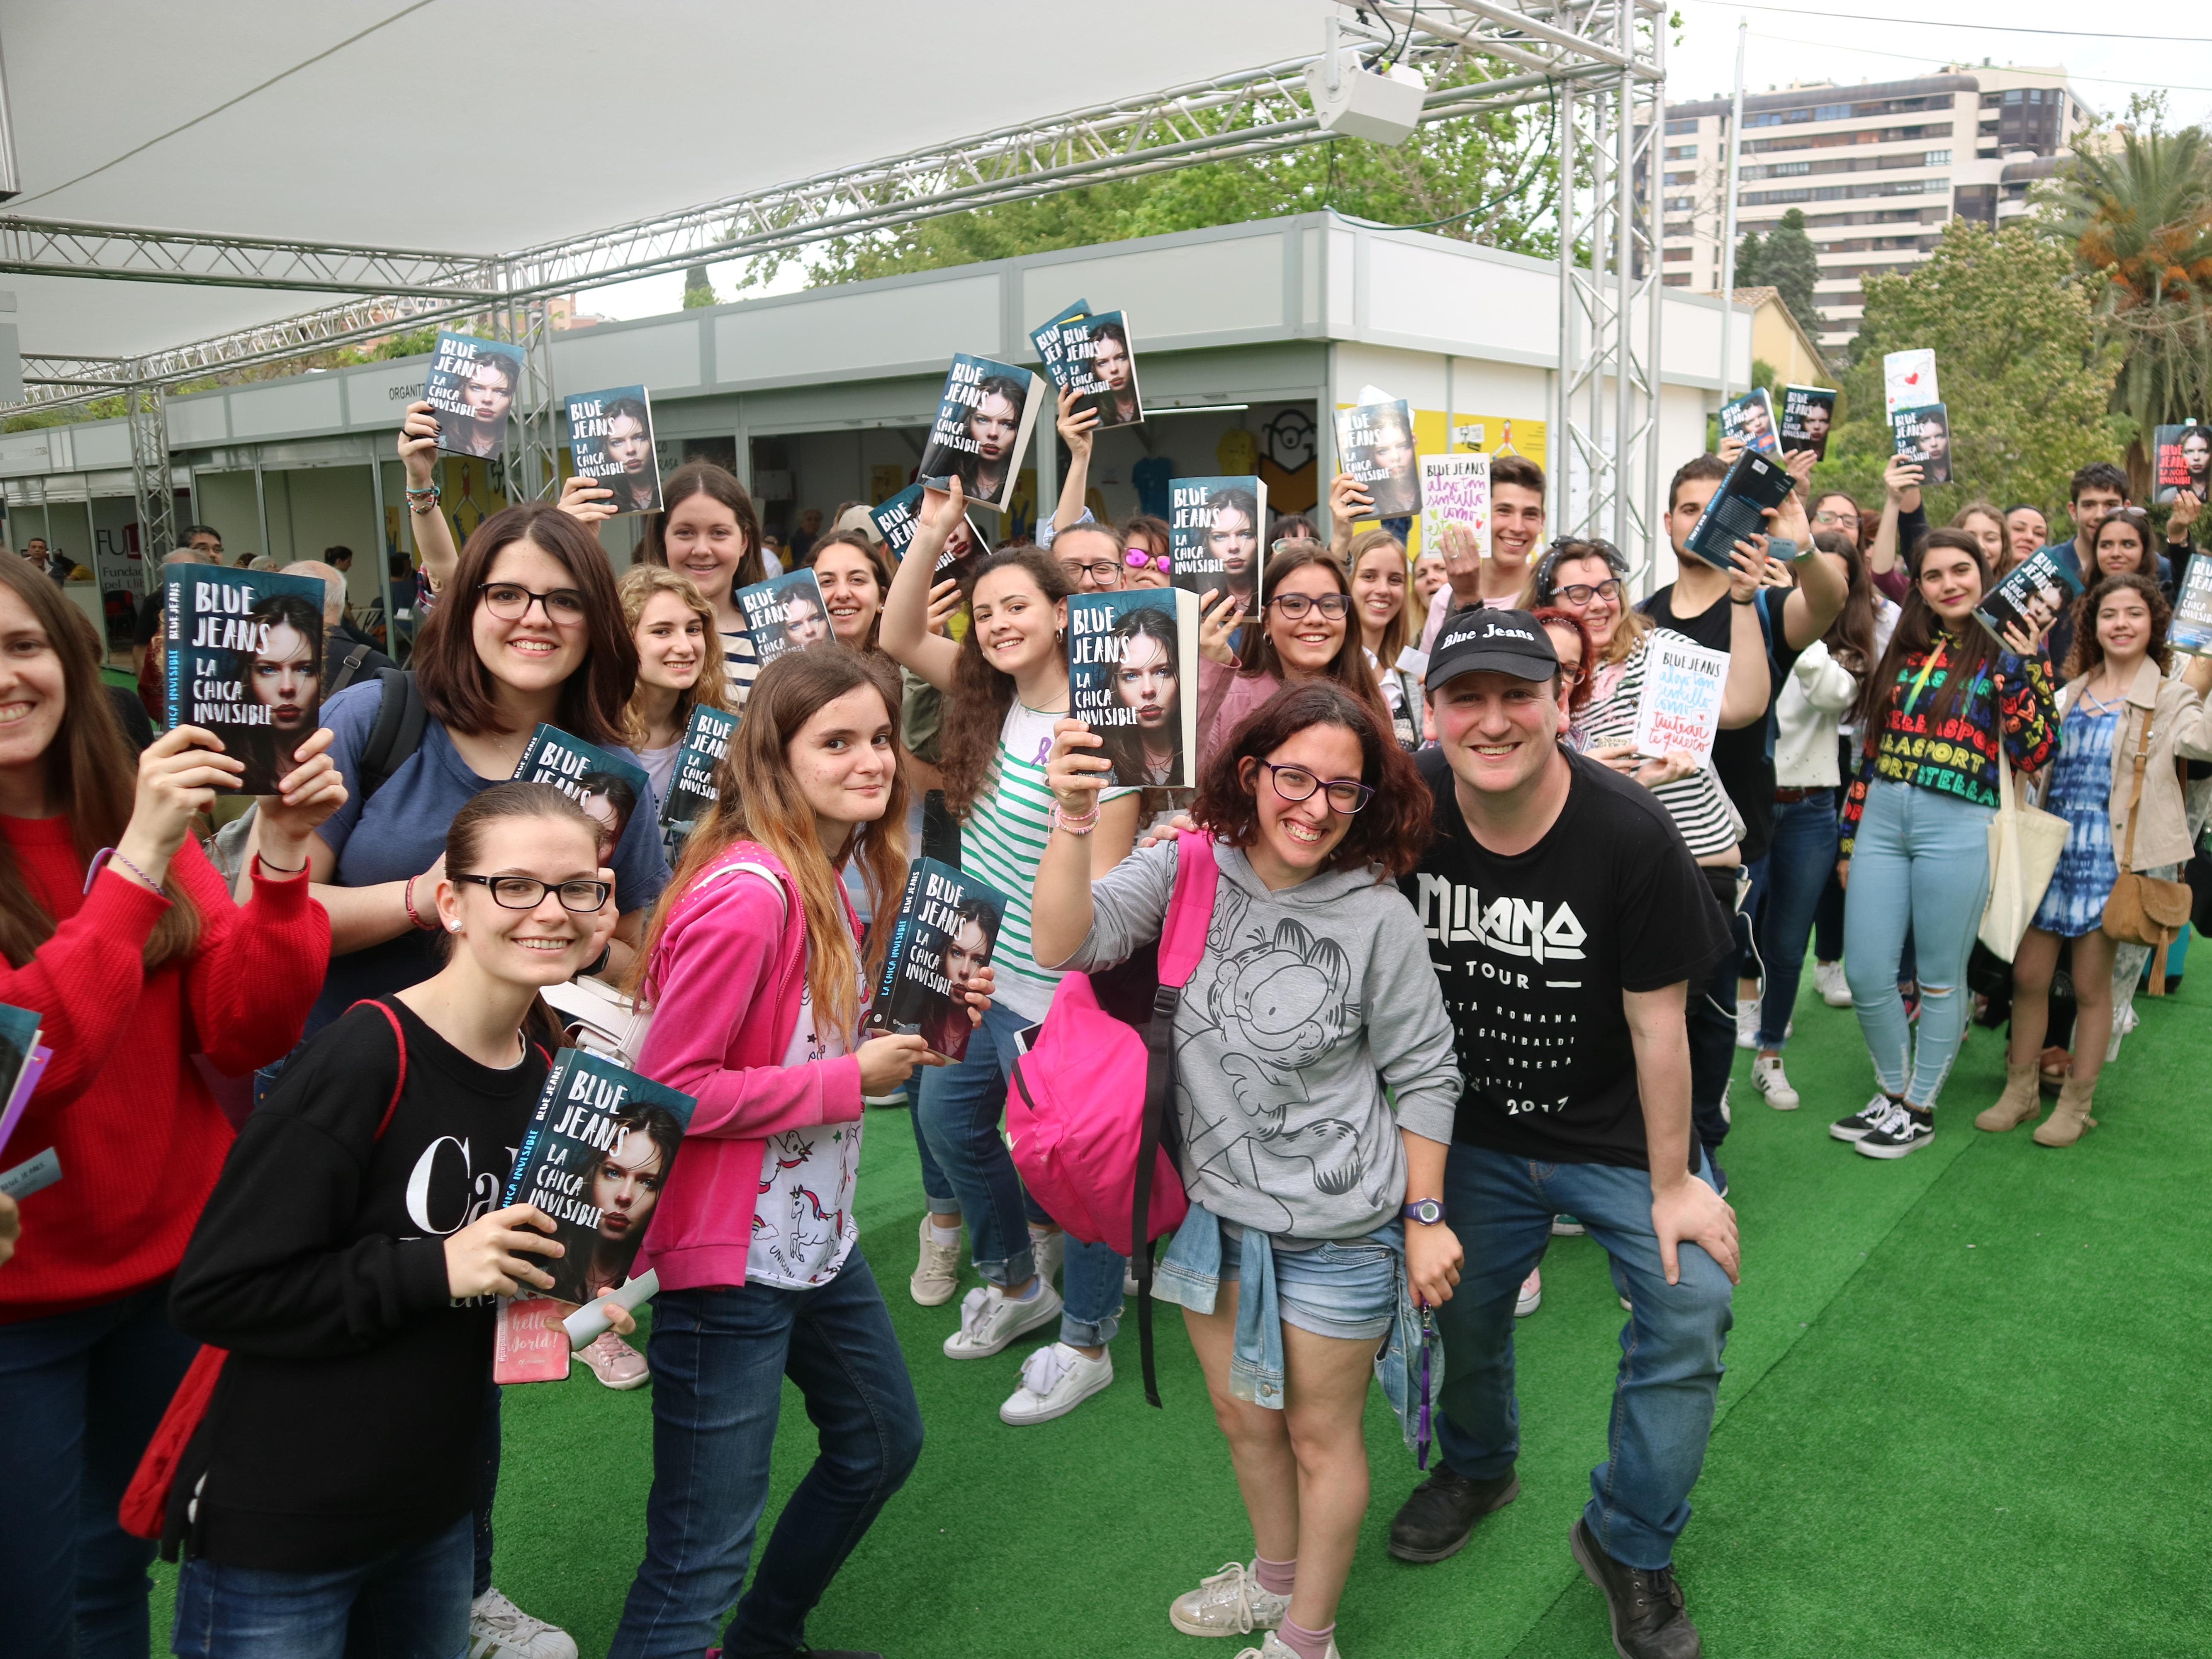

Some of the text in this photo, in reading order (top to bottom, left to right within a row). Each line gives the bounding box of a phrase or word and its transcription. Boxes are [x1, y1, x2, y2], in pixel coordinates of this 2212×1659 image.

[1063, 325, 1090, 346] BLUE
[440, 338, 478, 360] BLUE
[1044, 341, 1063, 365] JEA
[1066, 341, 1101, 362] JEANS
[434, 356, 484, 381] JEANS
[951, 362, 984, 386] BLUE
[1069, 365, 1080, 375] LA
[1071, 372, 1094, 387] CHICA
[433, 375, 446, 387] LA
[428, 386, 460, 402] CHICA
[944, 382, 990, 411] JEANS
[1787, 391, 1809, 404] BLUE
[426, 396, 477, 418] INVISIBLE
[570, 399, 603, 421] BLUE
[941, 405, 951, 418] LA
[1785, 403, 1813, 416] JEANS
[572, 417, 616, 440] JEANS
[936, 419, 964, 435] CHICA
[1339, 414, 1370, 431] BLUE
[1895, 412, 1918, 427] BLUE
[1342, 428, 1382, 449] JEANS
[1896, 423, 1925, 439] JEANS
[576, 444, 589, 455] LA
[932, 431, 981, 455] INVISIBLE
[2159, 444, 2183, 456] BLUE
[576, 452, 605, 467] CHICA
[1346, 452, 1357, 461] LA
[1346, 460, 1372, 472] CHICA
[2159, 456, 2189, 468] JEANS
[578, 461, 625, 477] INVISIBLE
[1352, 467, 1390, 482] NVISIBLE
[1427, 462, 1485, 477] BLUE JEANS
[1173, 487, 1209, 508] BLUE
[877, 502, 911, 533] BLUE
[1173, 508, 1220, 530] JEANS
[1175, 534, 1188, 547] LA
[1174, 546, 1204, 560] CHICA
[1174, 558, 1224, 575] INVISIBLE
[2032, 552, 2059, 578] BLUE
[2193, 560, 2212, 577] BLU
[2021, 563, 2053, 594] JEANS
[195, 581, 255, 615] BLUE
[743, 588, 777, 613] BLUE
[2183, 599, 2207, 612] CHICA
[2186, 590, 2197, 600] LA
[750, 602, 793, 630] JEANS
[1073, 606, 1115, 635] BLUE
[192, 616, 270, 655] JEANS
[755, 632, 768, 644] LA
[758, 637, 786, 656] CHICA
[1440, 623, 1535, 650] Blue Jeans
[169, 581, 181, 729] HICA INVISIBLE BLUE JEANS
[1072, 636, 1131, 665] JEANS
[196, 657, 217, 677] LA
[1659, 664, 1691, 686] algo
[1663, 652, 1721, 678] BLUE JEANS
[193, 679, 242, 701] CHICA
[1076, 672, 1091, 688] LA
[1074, 688, 1112, 708] CHICA
[194, 703, 273, 726] INVISIBLE
[1076, 706, 1138, 727] INVISIBLE
[1653, 710, 1709, 739] tuitear
[697, 715, 732, 740] BLUE
[690, 734, 728, 761] JEAN
[1649, 727, 1711, 753] te quiero
[514, 737, 538, 779] BLUE JEANS
[538, 742, 591, 780] BLUE
[688, 754, 700, 767] LA
[683, 766, 712, 784] CHICA
[925, 873, 965, 909] BLUE
[918, 900, 967, 941] JEANS
[881, 871, 920, 996] LA CHICA INVISIBLE BLUE JEANS
[915, 929, 930, 947] LA
[909, 945, 941, 971] CHICA
[905, 963, 954, 997] INVISIBLE
[1466, 960, 1529, 989] TOUR
[1497, 1005, 1577, 1024] ROMANA
[1480, 1028, 1574, 1046] GARIBALDI
[1508, 1056, 1572, 1069] BRERA
[567, 1070, 629, 1116] BLUE
[502, 1064, 565, 1209] HICA INVISIBLE BLUE JEANS
[554, 1105, 630, 1158] JEANS
[546, 1143, 569, 1167] LA
[536, 1164, 584, 1197] CHICA
[528, 1188, 606, 1230] INVISIBLE
[770, 1245, 795, 1278] UNICORN
